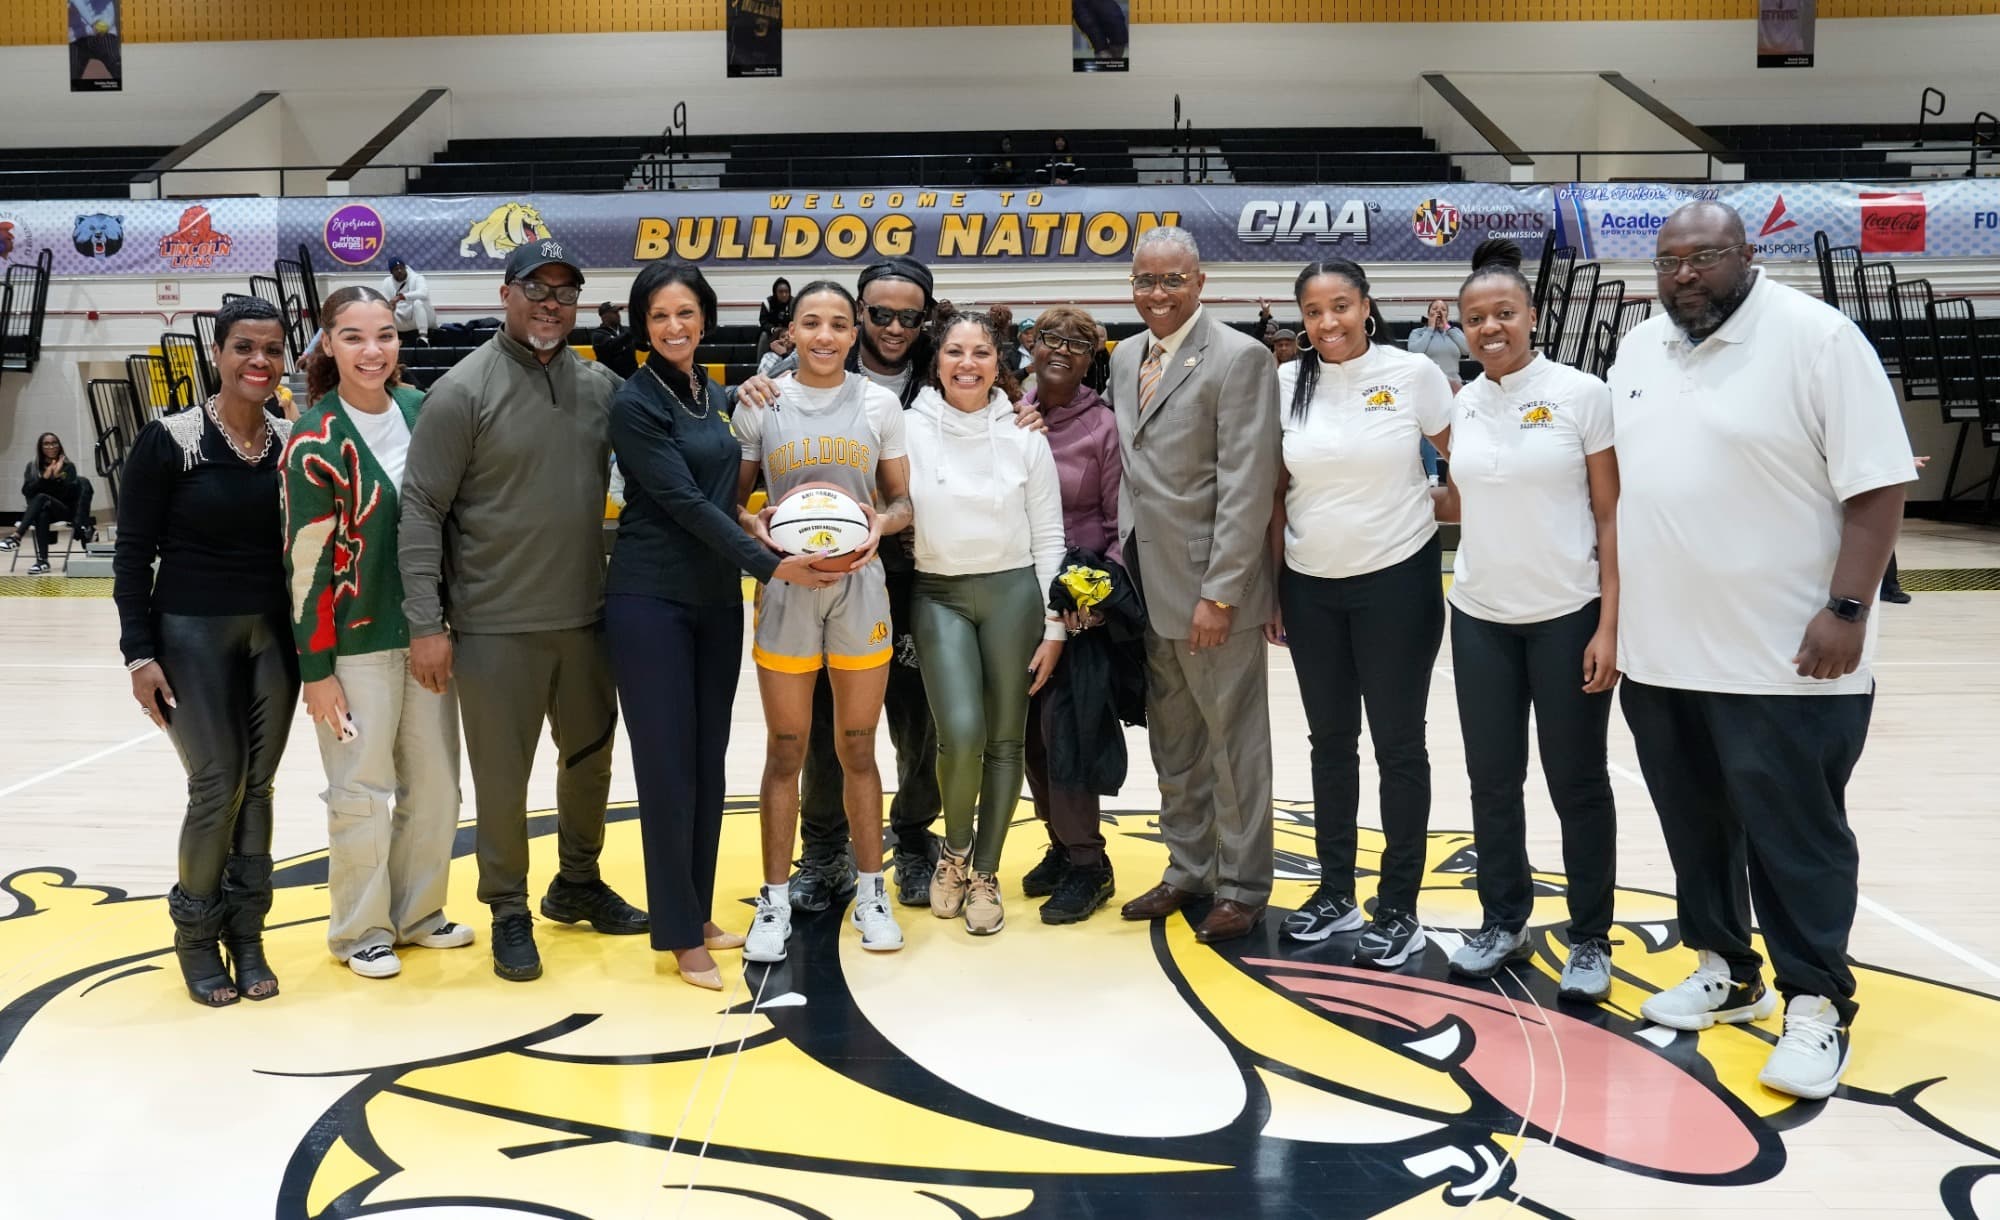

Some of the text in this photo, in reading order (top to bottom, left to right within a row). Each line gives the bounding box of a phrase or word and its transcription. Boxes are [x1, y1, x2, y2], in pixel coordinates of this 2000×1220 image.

[769, 192, 1043, 209] WELCOME TO
[332, 217, 376, 234] Experience
[1461, 212, 1544, 230] SPORTS
[633, 213, 915, 260] BULLDOG
[160, 242, 230, 257] LINCOLN
[171, 256, 212, 269] LIONS
[768, 435, 870, 483] BULLDOGS
